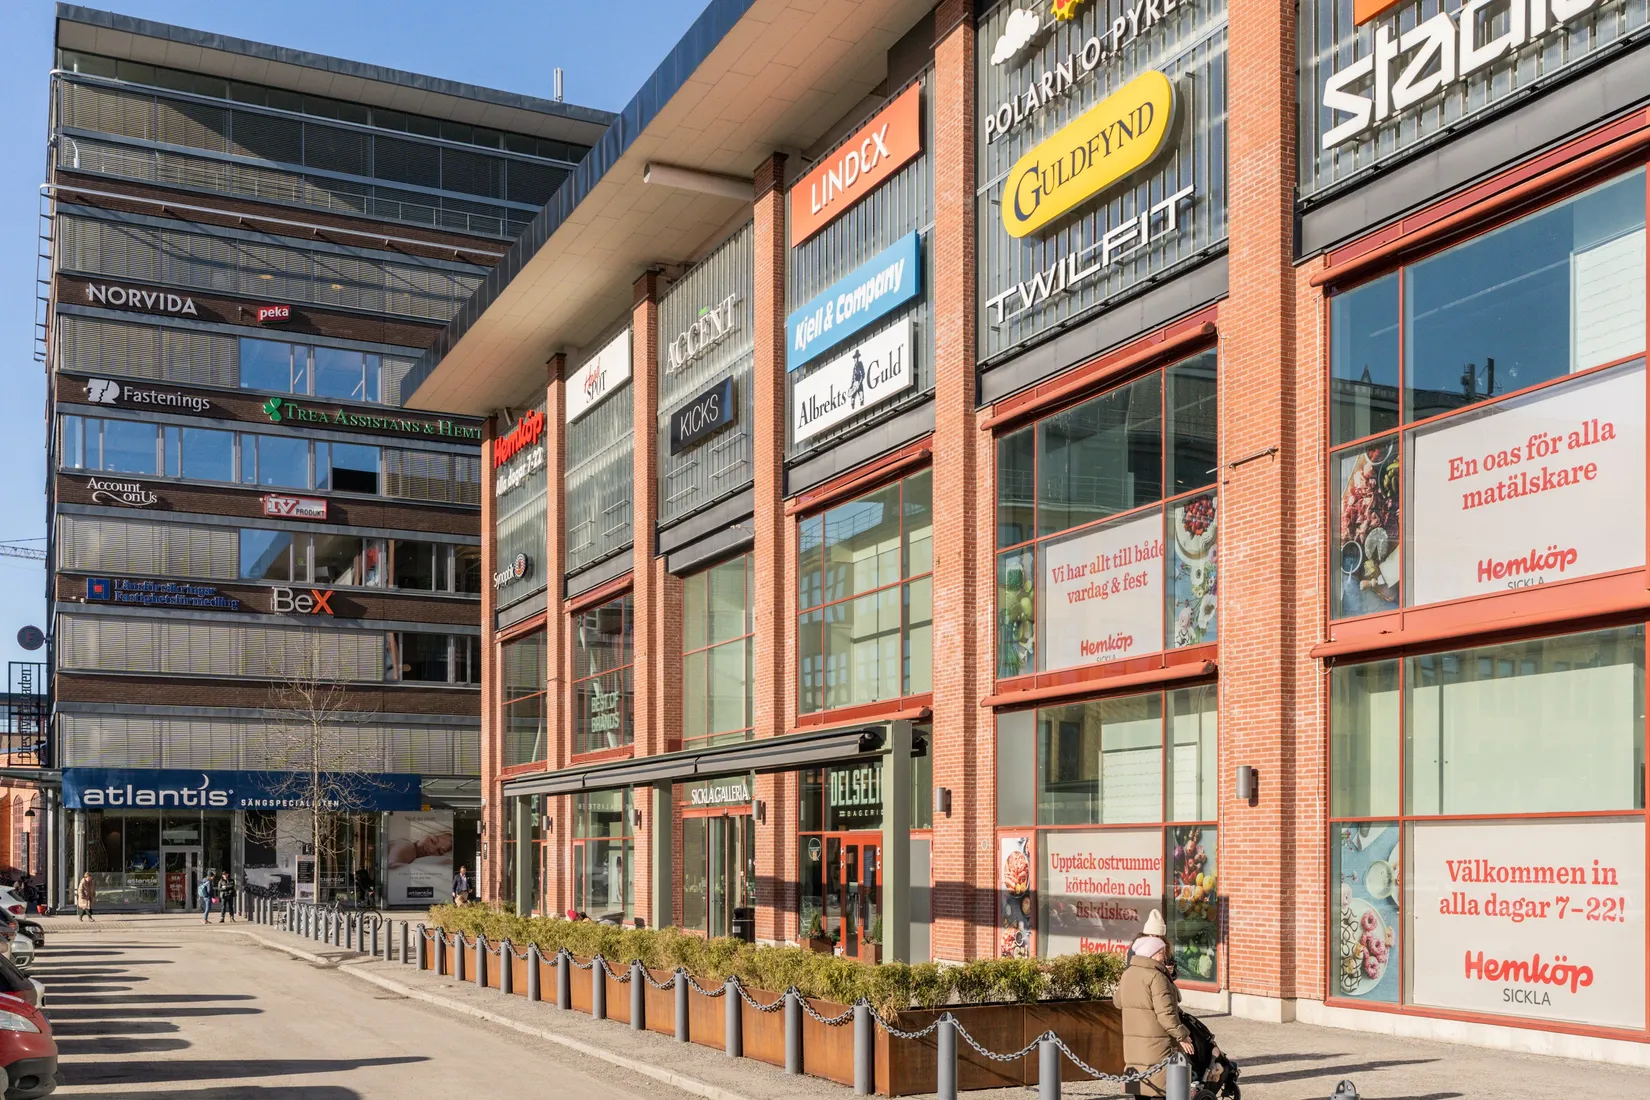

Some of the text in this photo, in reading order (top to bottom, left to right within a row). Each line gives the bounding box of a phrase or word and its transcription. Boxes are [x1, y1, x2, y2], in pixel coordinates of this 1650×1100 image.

[985, 53, 1075, 145] POLARN
[1113, 0, 1187, 53] PYR
[811, 122, 889, 215] LINDEX
[1013, 101, 1155, 222] GULDFYND
[985, 184, 1197, 323] TWILFIT
[88, 282, 198, 316] NORVIDA
[260, 306, 290, 321] peka
[795, 257, 905, 351] Kjell & Company
[665, 292, 736, 375] ACCENT
[124, 386, 211, 412] Fastenings
[797, 343, 904, 430] Albrekts Guld
[423, 423, 434, 435] &
[680, 393, 719, 441] KICKS
[493, 409, 545, 469] Hemköp
[1448, 418, 1616, 482] En oas för alla
[86, 477, 141, 493] Account
[1462, 462, 1598, 511] matälskare
[295, 508, 325, 518] PRODUKT
[493, 563, 515, 590] Synoptik
[1052, 540, 1164, 584] Vi har allt till både
[1477, 544, 1578, 583] Hemköp
[114, 579, 217, 597] Länsförsäkringar
[114, 590, 240, 610] Fastighetsförmedling
[1067, 570, 1148, 604] vardag & fest
[1080, 632, 1133, 657] Hemköp
[591, 691, 619, 713] BEST OF
[591, 712, 620, 733] BRANDS
[83, 774, 229, 807] atlantis
[691, 787, 714, 805] SICKLA
[1051, 852, 1096, 873] Upptäck
[1446, 859, 1618, 885] Välkommen in
[1065, 876, 1152, 896] köttboden och
[1075, 900, 1138, 921] fiskdisken
[1439, 892, 1480, 916] alla
[1484, 893, 1551, 923] dagar
[1465, 950, 1594, 994] Hemköp
[1503, 988, 1552, 1006] SICKLA
